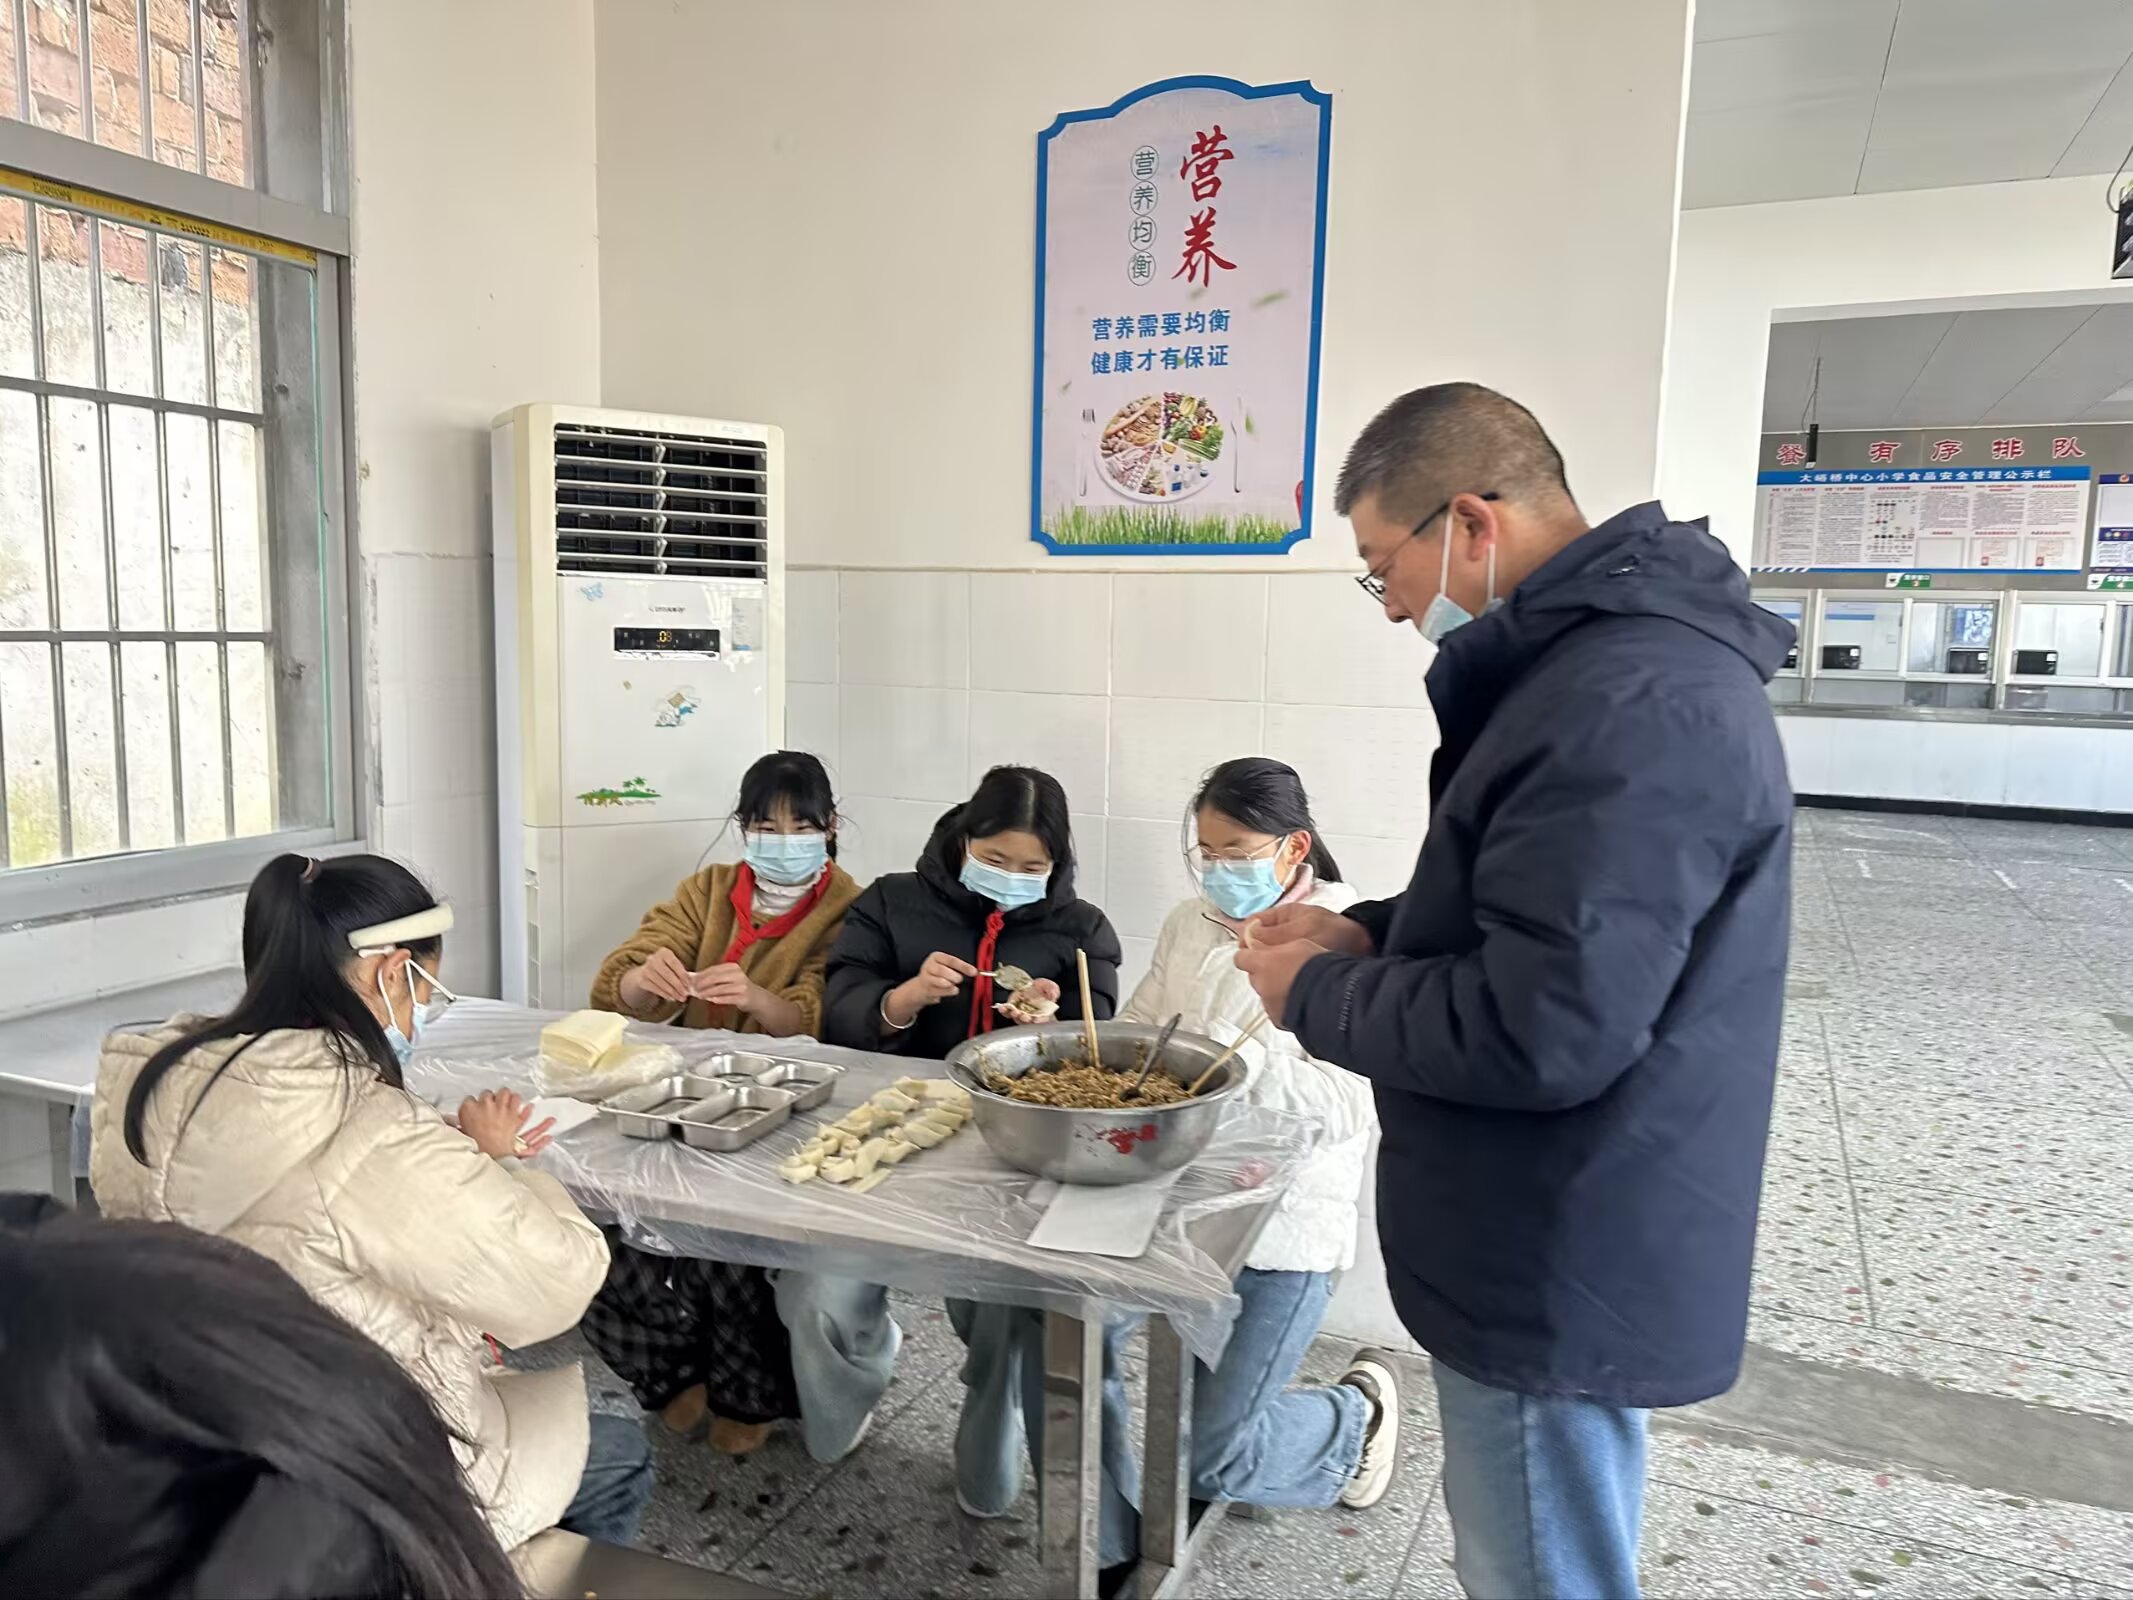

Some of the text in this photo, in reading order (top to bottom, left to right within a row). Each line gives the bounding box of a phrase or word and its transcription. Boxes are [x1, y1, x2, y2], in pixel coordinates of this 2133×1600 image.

[1131, 150, 1157, 281] 营养均衡
[1172, 125, 1238, 287] 营养
[1092, 309, 1230, 341] 营养需要均衡
[1091, 344, 1229, 375] 健康才有保证
[1777, 437, 2086, 465] 餐 有序排队
